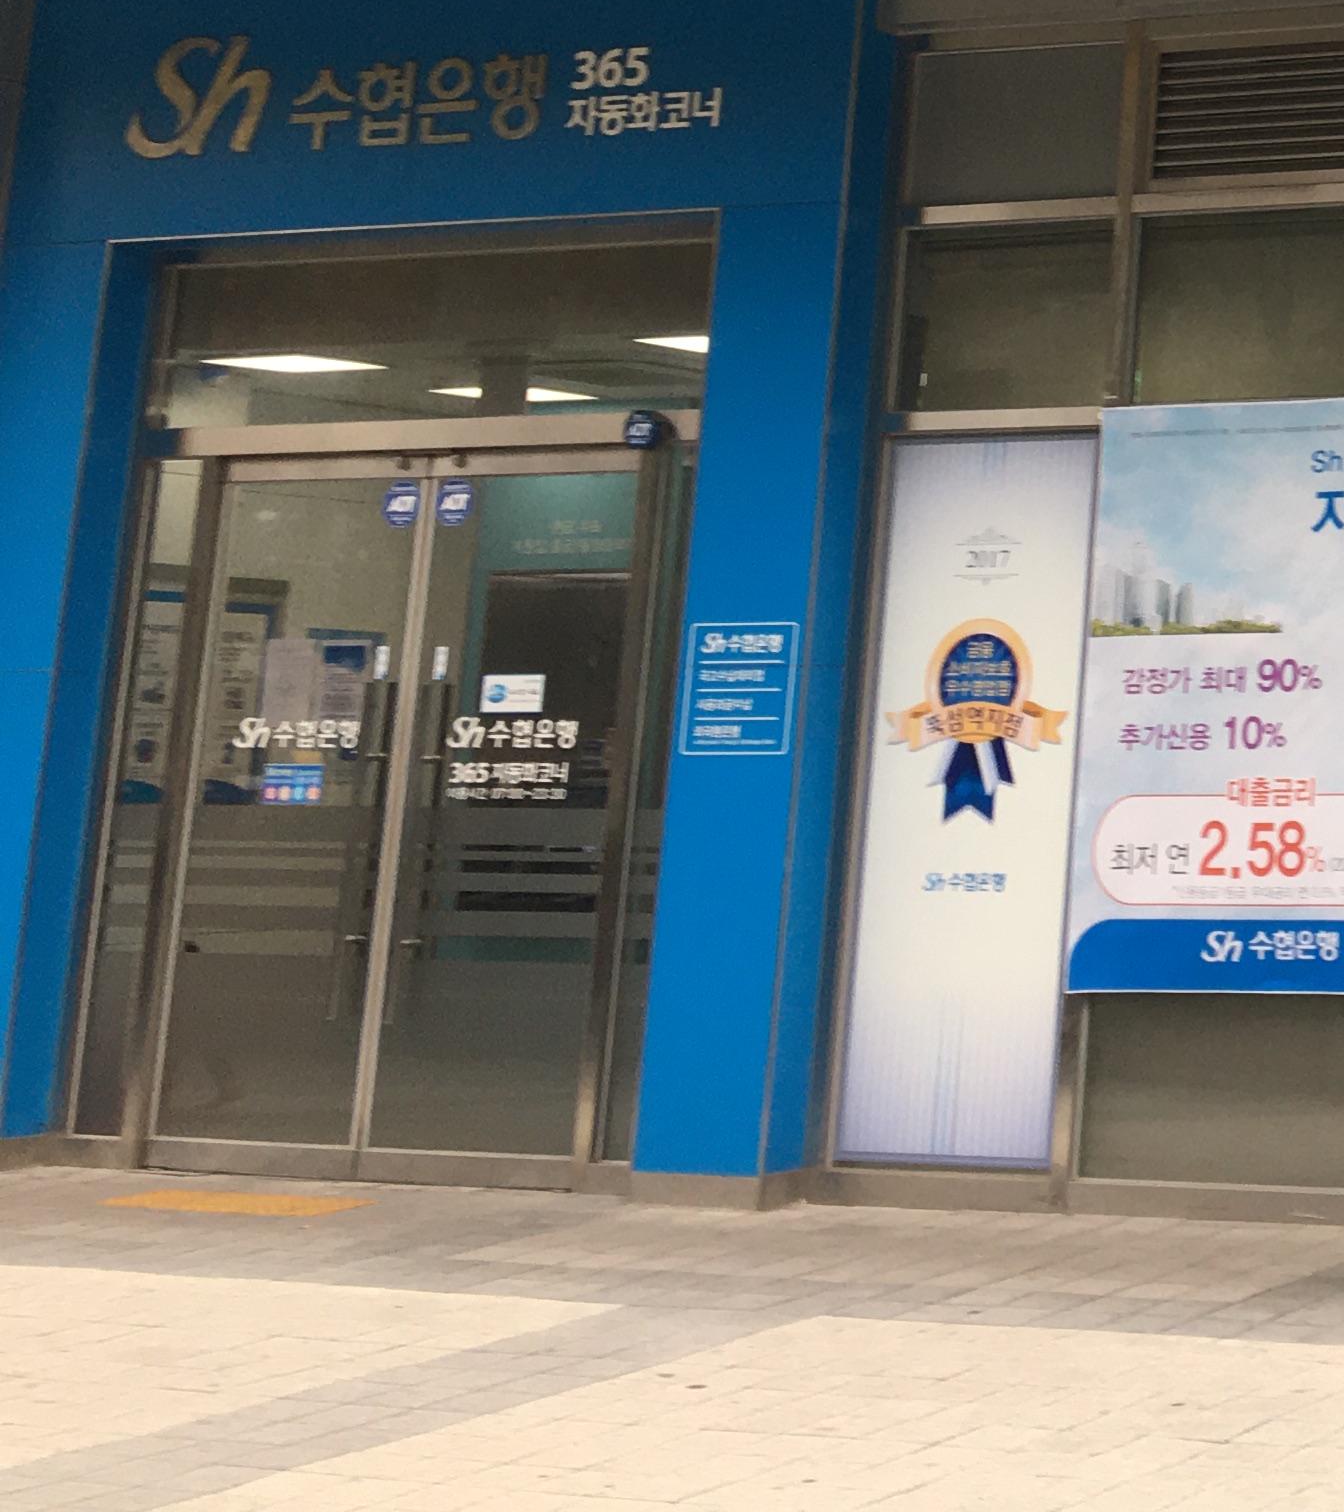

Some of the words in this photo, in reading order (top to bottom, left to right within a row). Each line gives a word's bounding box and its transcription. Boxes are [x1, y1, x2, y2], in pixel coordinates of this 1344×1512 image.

[571, 46, 651, 91] 365
[123, 34, 274, 159] Sh
[287, 53, 549, 151] 수협은행
[563, 87, 724, 136] 자동화코너
[1311, 449, 1343, 474] Sh
[965, 549, 1011, 569] 2017
[1121, 666, 1192, 695] 감정가
[1200, 666, 1249, 694] 최대
[1256, 658, 1324, 693] 90%
[272, 719, 362, 749] 수협은행
[487, 719, 580, 749] 수협은행
[1117, 721, 1213, 751] 추가신용
[1223, 716, 1288, 750] 10%
[448, 762, 490, 784] 365
[1225, 776, 1317, 807] 대출금리
[1110, 843, 1158, 875] 최저
[1166, 843, 1191, 875] 연
[1198, 820, 1327, 879] 2.58%
[946, 872, 1007, 893] 수협은행
[1201, 931, 1242, 964] Sh
[1247, 931, 1341, 962] 수협은행
